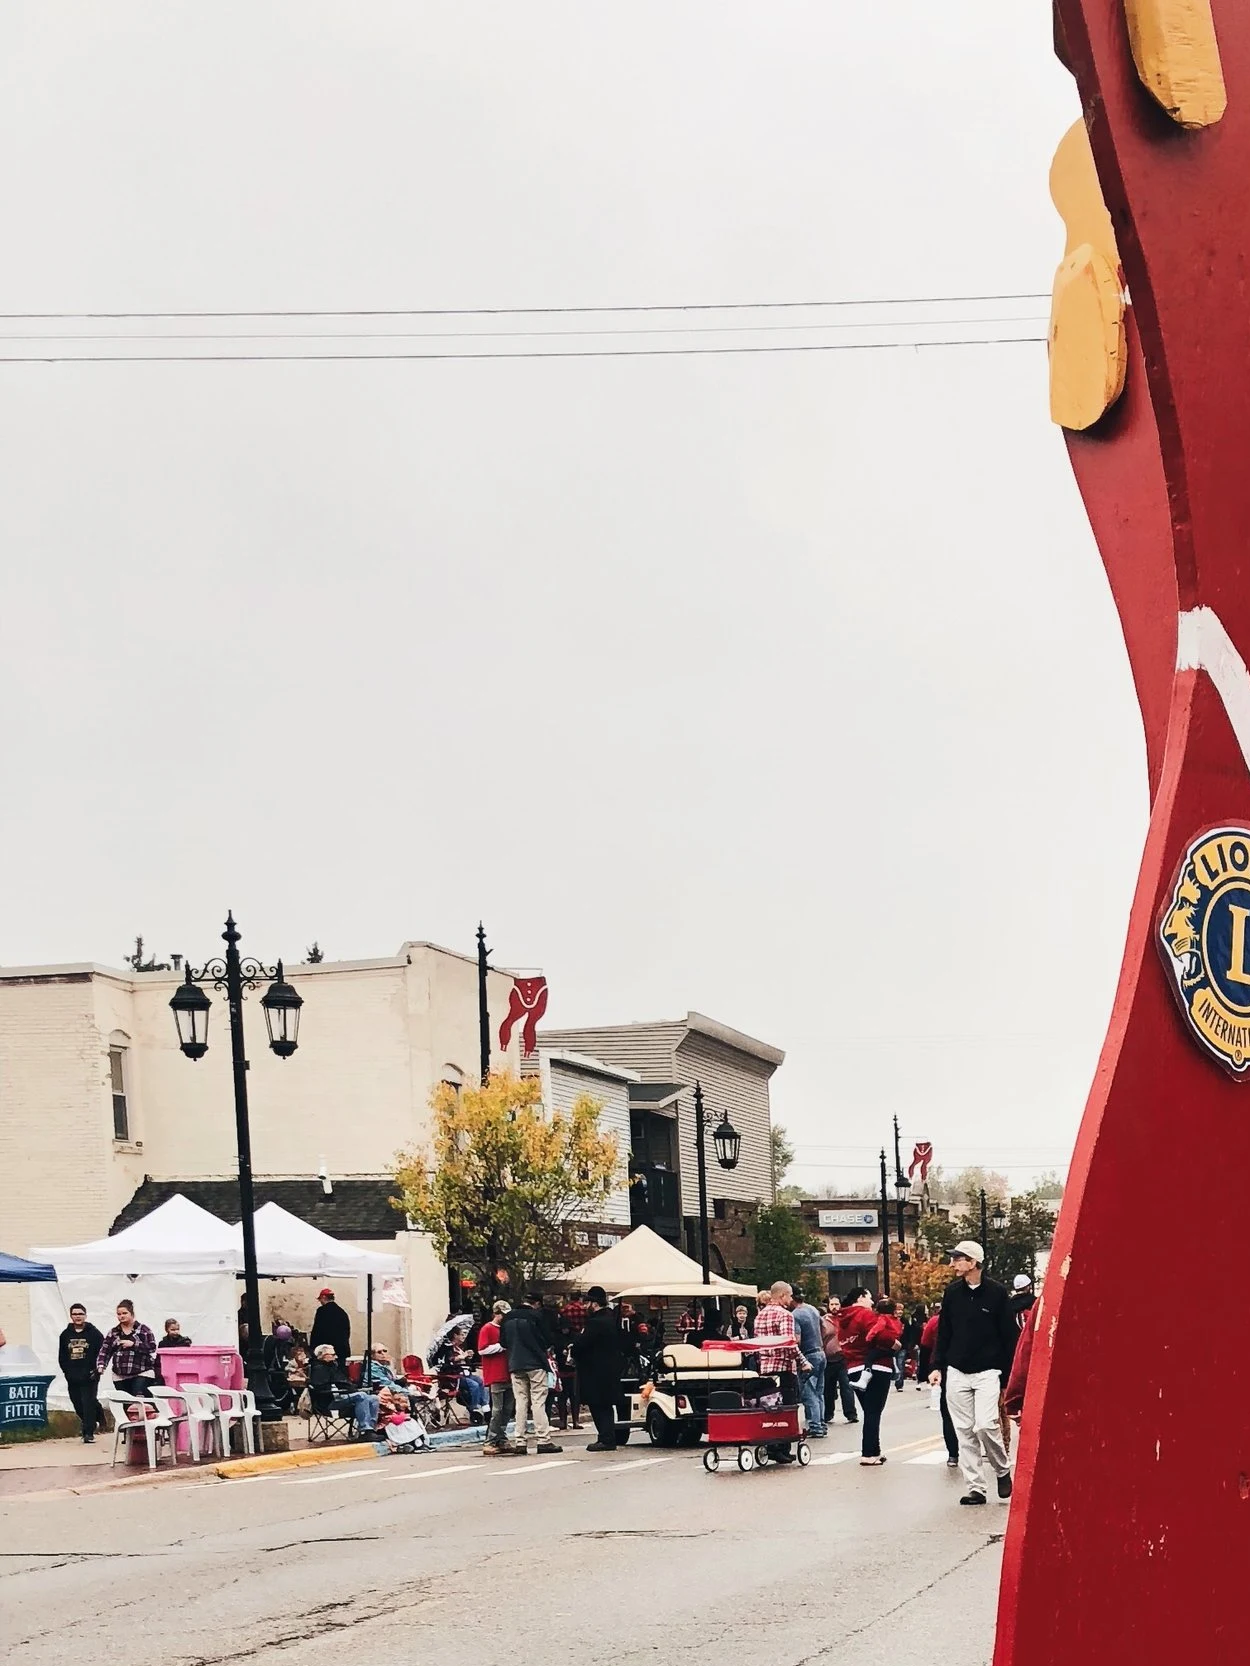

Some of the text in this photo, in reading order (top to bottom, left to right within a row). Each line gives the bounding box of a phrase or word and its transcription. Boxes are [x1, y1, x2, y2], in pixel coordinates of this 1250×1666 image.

[823, 1214, 863, 1224] CHASE
[9, 1385, 38, 1399] BATH
[5, 1403, 41, 1418] FITTER
